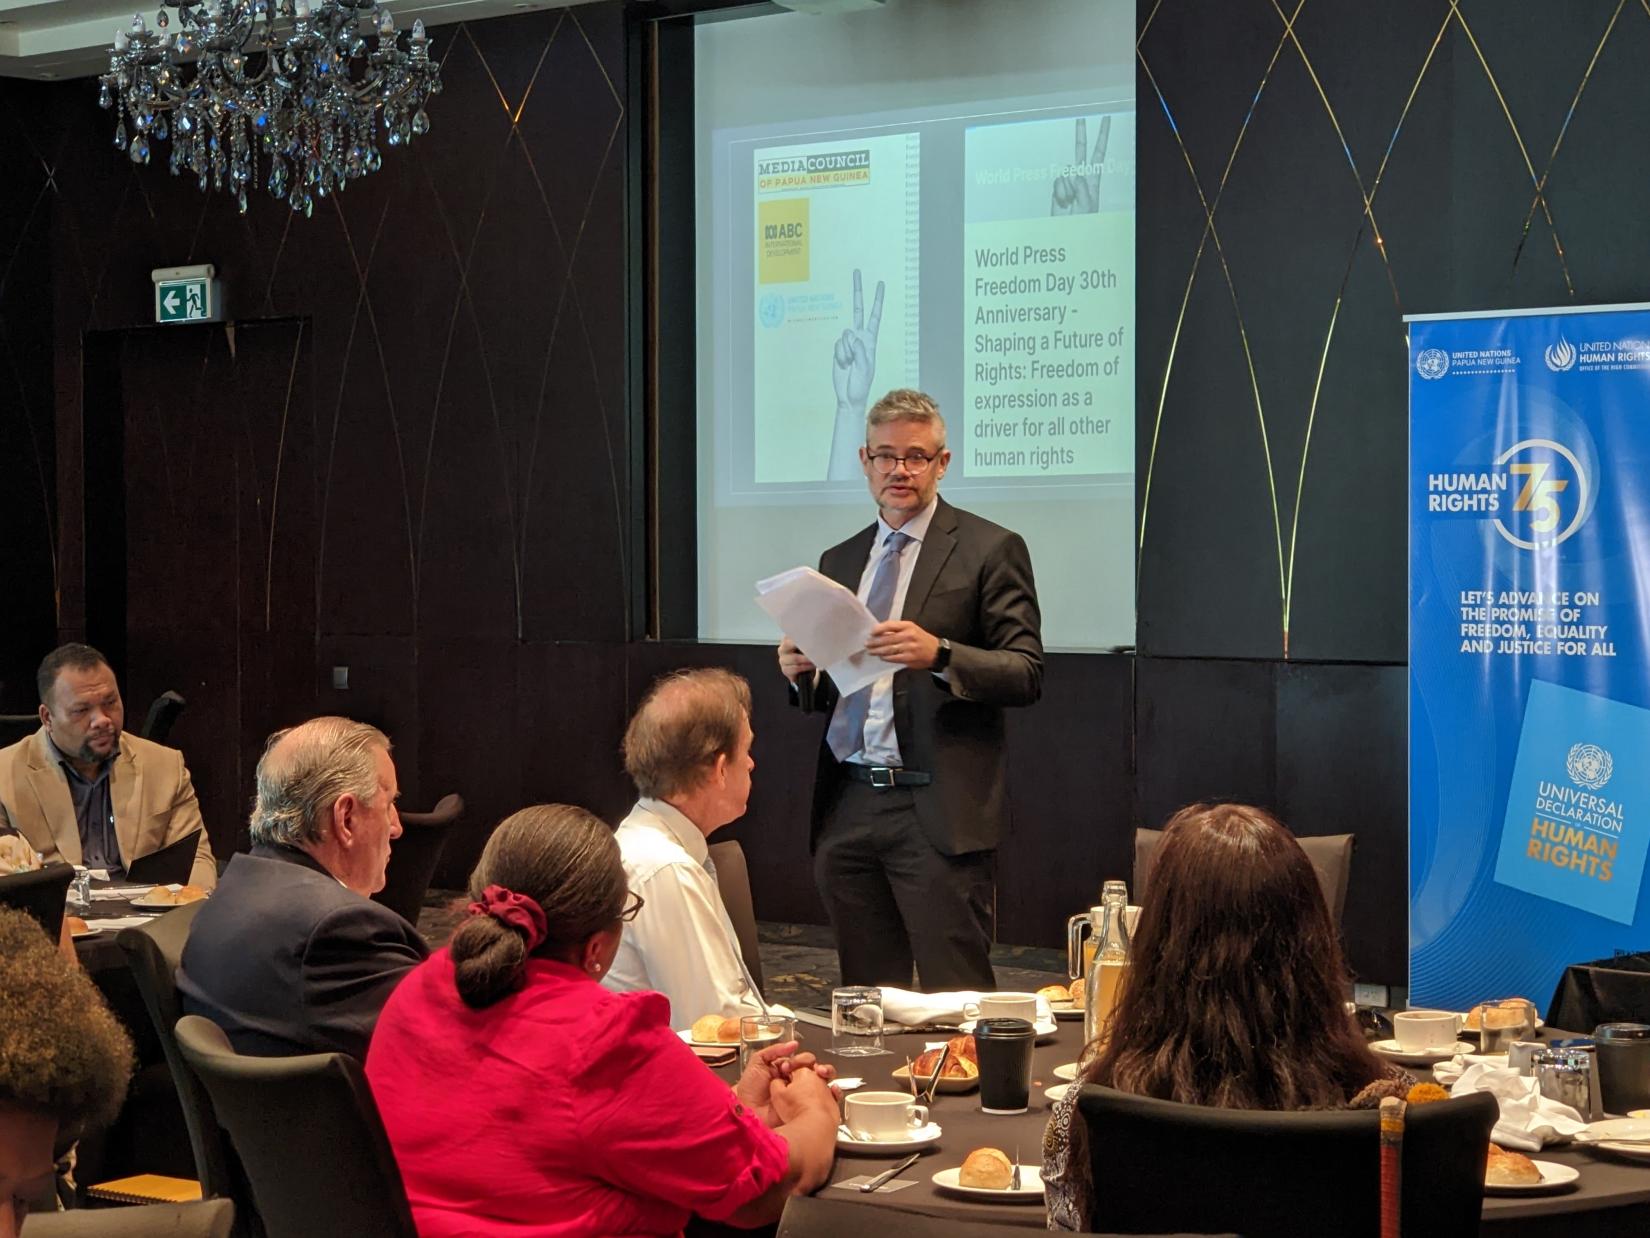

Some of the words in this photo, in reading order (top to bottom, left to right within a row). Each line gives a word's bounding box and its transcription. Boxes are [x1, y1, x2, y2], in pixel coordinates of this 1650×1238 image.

[759, 159, 807, 176] MEDIA
[807, 153, 869, 171] COUNCIL
[975, 166, 1010, 185] World
[1013, 166, 1048, 182] Press
[1050, 160, 1104, 180] Freedom
[760, 178, 772, 189] OF
[775, 175, 807, 187] PAPUA
[810, 173, 831, 185] NEW
[833, 170, 869, 182] GUINEA
[779, 222, 803, 239] ABC
[975, 246, 1019, 268] World
[1023, 245, 1067, 264] Press
[975, 275, 1042, 297] Freedom
[1046, 272, 1075, 295] Day
[1079, 268, 1117, 290] 30th
[975, 303, 1067, 326] Anniversary
[975, 332, 1036, 358] Shaping
[1041, 335, 1049, 350] a
[1053, 330, 1104, 350] Future
[1107, 326, 1125, 347] of
[1579, 341, 1612, 352] UNITED
[1452, 350, 1479, 359] UNITED
[1479, 349, 1512, 358] NATIONS
[1452, 358, 1476, 367] PAPUA
[1477, 358, 1494, 366] NEW
[1495, 357, 1521, 365] GUINEA
[1580, 353, 1615, 363] HUMAN
[1617, 351, 1650, 362] RIGHTS
[975, 362, 1027, 386] Rights:
[1031, 359, 1099, 380] Freedom
[1103, 356, 1120, 376] of
[974, 388, 1058, 414] expression
[1062, 390, 1080, 407] as
[1084, 391, 1093, 406] a
[974, 418, 1019, 438] driver
[1022, 417, 1044, 437] for
[1047, 416, 1065, 436] all
[1069, 415, 1112, 435] other
[974, 447, 1026, 467] human
[1029, 446, 1075, 470] rights
[1429, 473, 1507, 491] HUMAN
[1429, 494, 1500, 512] RIGHTS
[1510, 463, 1569, 533] 75
[1574, 592, 1599, 606] ON
[1461, 607, 1486, 620] THE
[1560, 608, 1581, 622] OF
[1461, 624, 1531, 640] FREEDOM,
[1536, 625, 1608, 639] EQUALITY
[1461, 640, 1493, 653] AND
[1498, 641, 1551, 655] JUSTICE
[1557, 642, 1586, 655] FOR
[1591, 643, 1616, 656] ALL
[1539, 781, 1624, 819] UNIVERSAL
[1535, 797, 1623, 833] DECLARATION
[1531, 817, 1618, 859] HUMAN
[1527, 838, 1613, 881] RIGHTS
